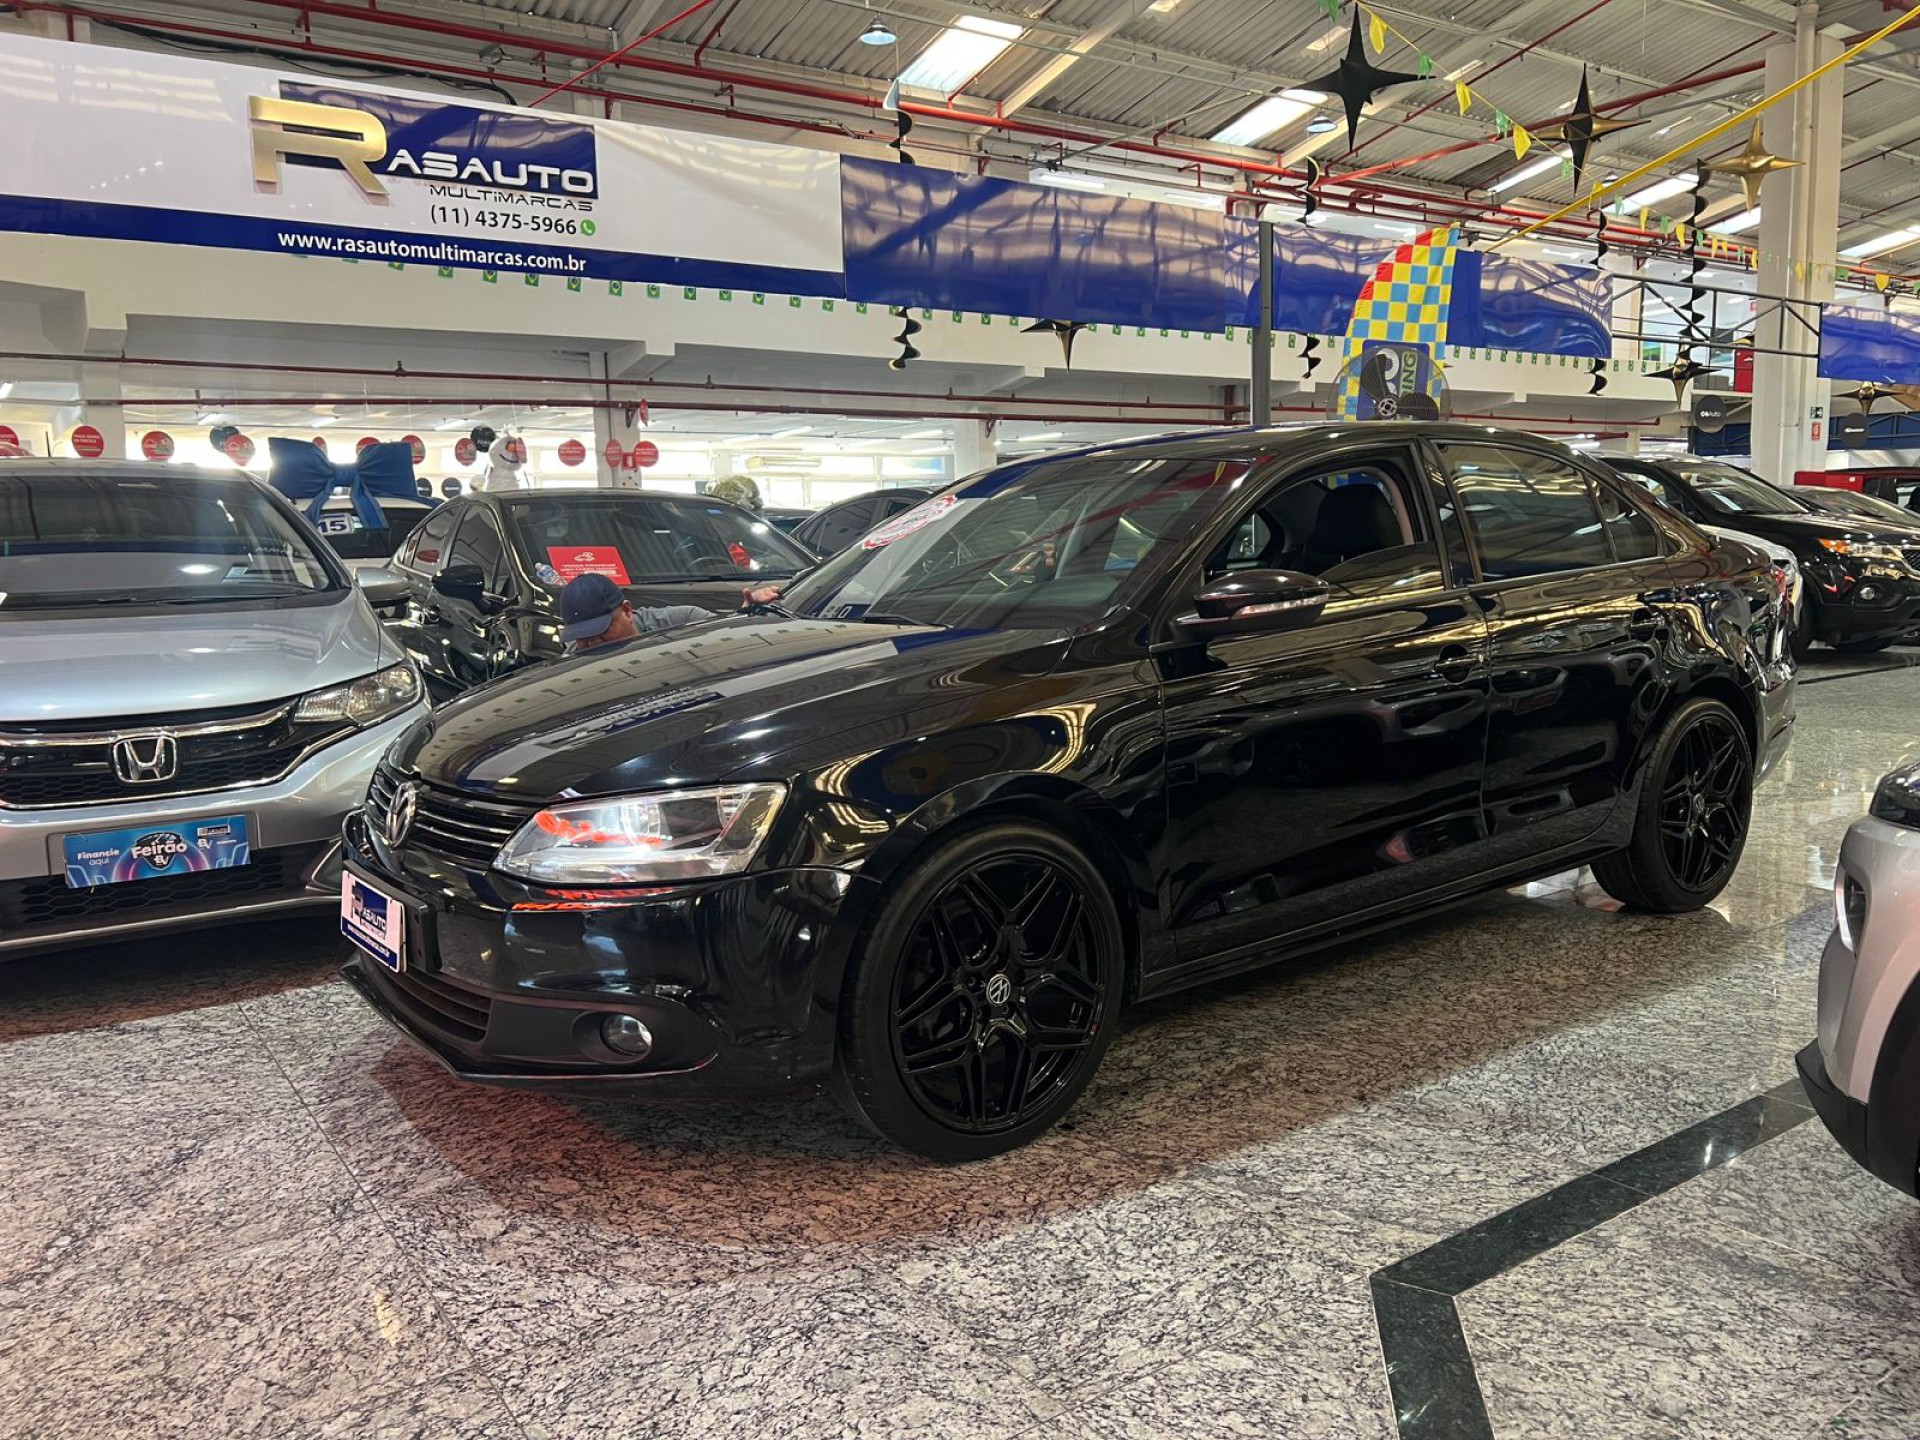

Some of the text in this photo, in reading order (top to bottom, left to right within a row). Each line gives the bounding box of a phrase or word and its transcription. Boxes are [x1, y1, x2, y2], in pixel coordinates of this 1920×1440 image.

[430, 204, 578, 236] (11) 4375-5966
[277, 230, 587, 273] www.rasautomultimarcas.com.br
[77, 847, 120, 860] Financie
[130, 837, 188, 860] Feirão
[89, 857, 110, 867] aqui
